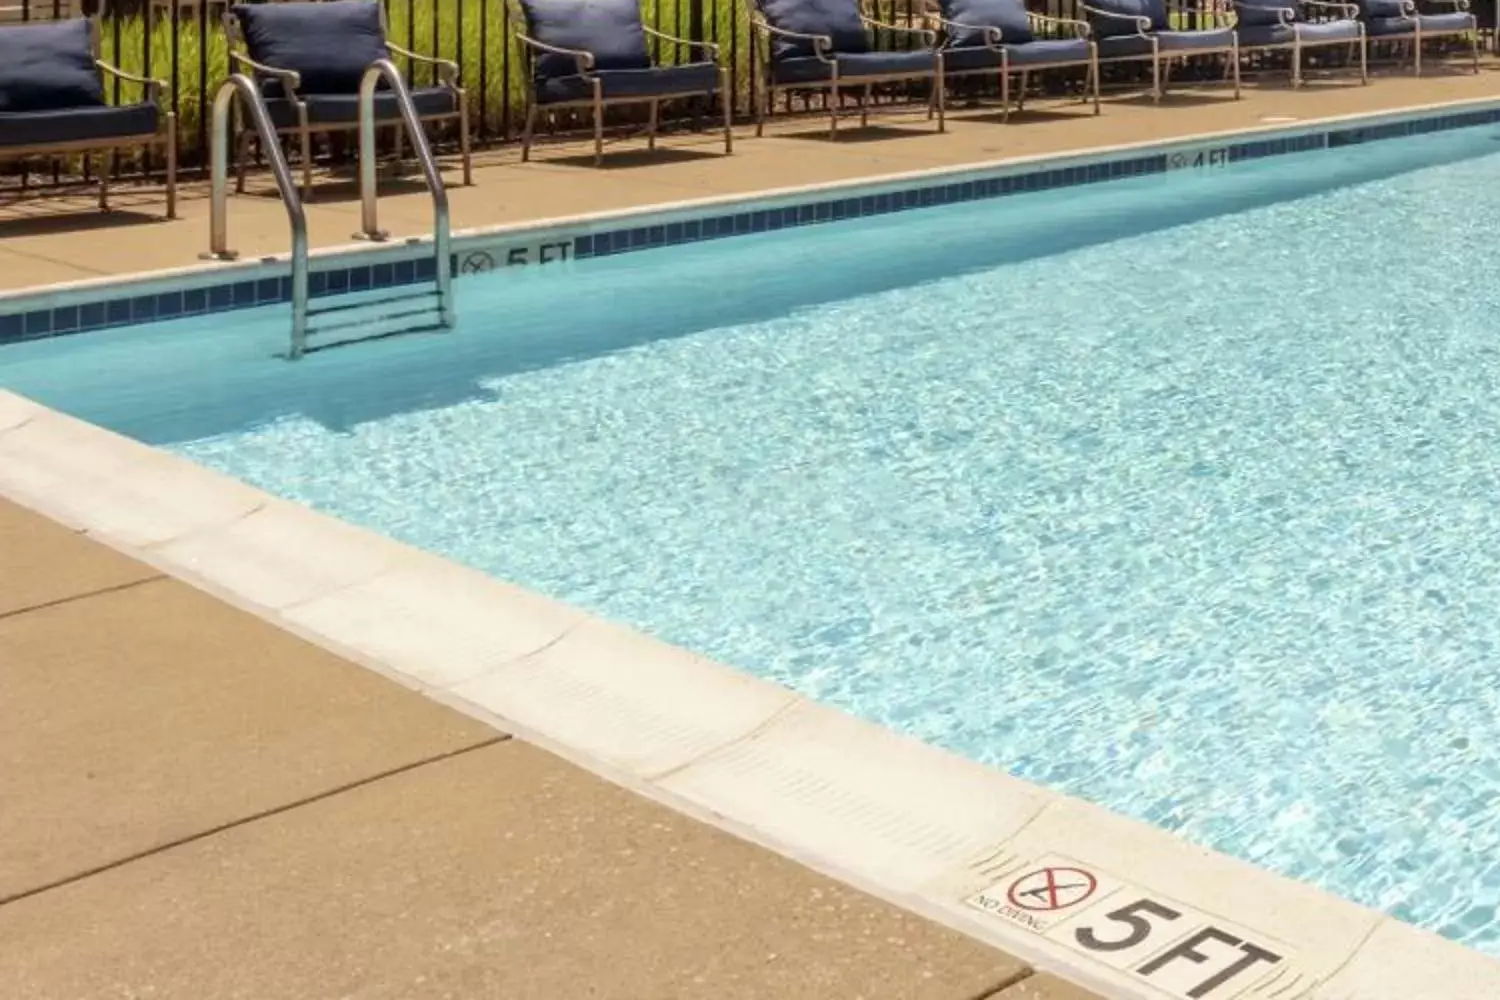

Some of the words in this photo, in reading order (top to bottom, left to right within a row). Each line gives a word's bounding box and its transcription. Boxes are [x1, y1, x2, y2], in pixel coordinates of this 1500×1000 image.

[506, 247, 528, 266] 5
[540, 241, 573, 265] FT
[974, 894, 1001, 909] NO
[996, 905, 1050, 932] DIVING
[1075, 898, 1183, 952] 5
[1135, 925, 1283, 1000] FT
